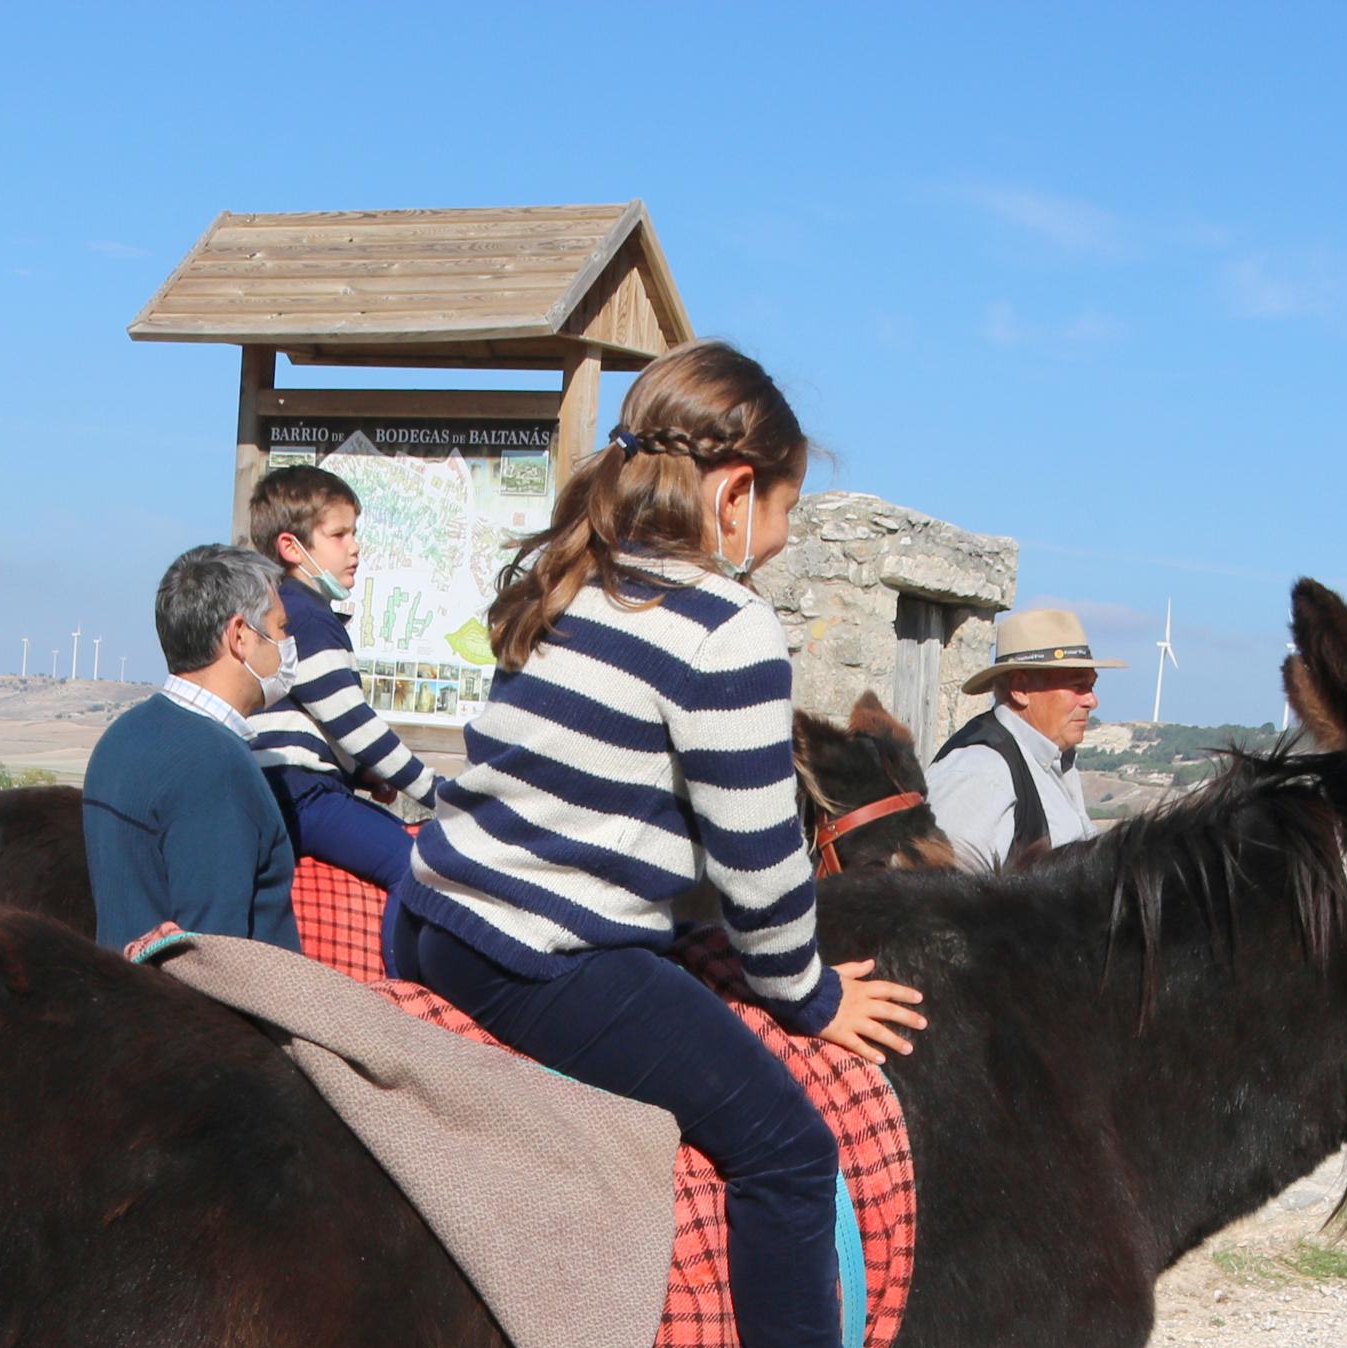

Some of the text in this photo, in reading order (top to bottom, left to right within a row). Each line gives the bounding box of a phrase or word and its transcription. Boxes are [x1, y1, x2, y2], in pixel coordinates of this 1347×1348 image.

[270, 426, 551, 446] BARRIO DE BODEGAS DE BALTANÁS
